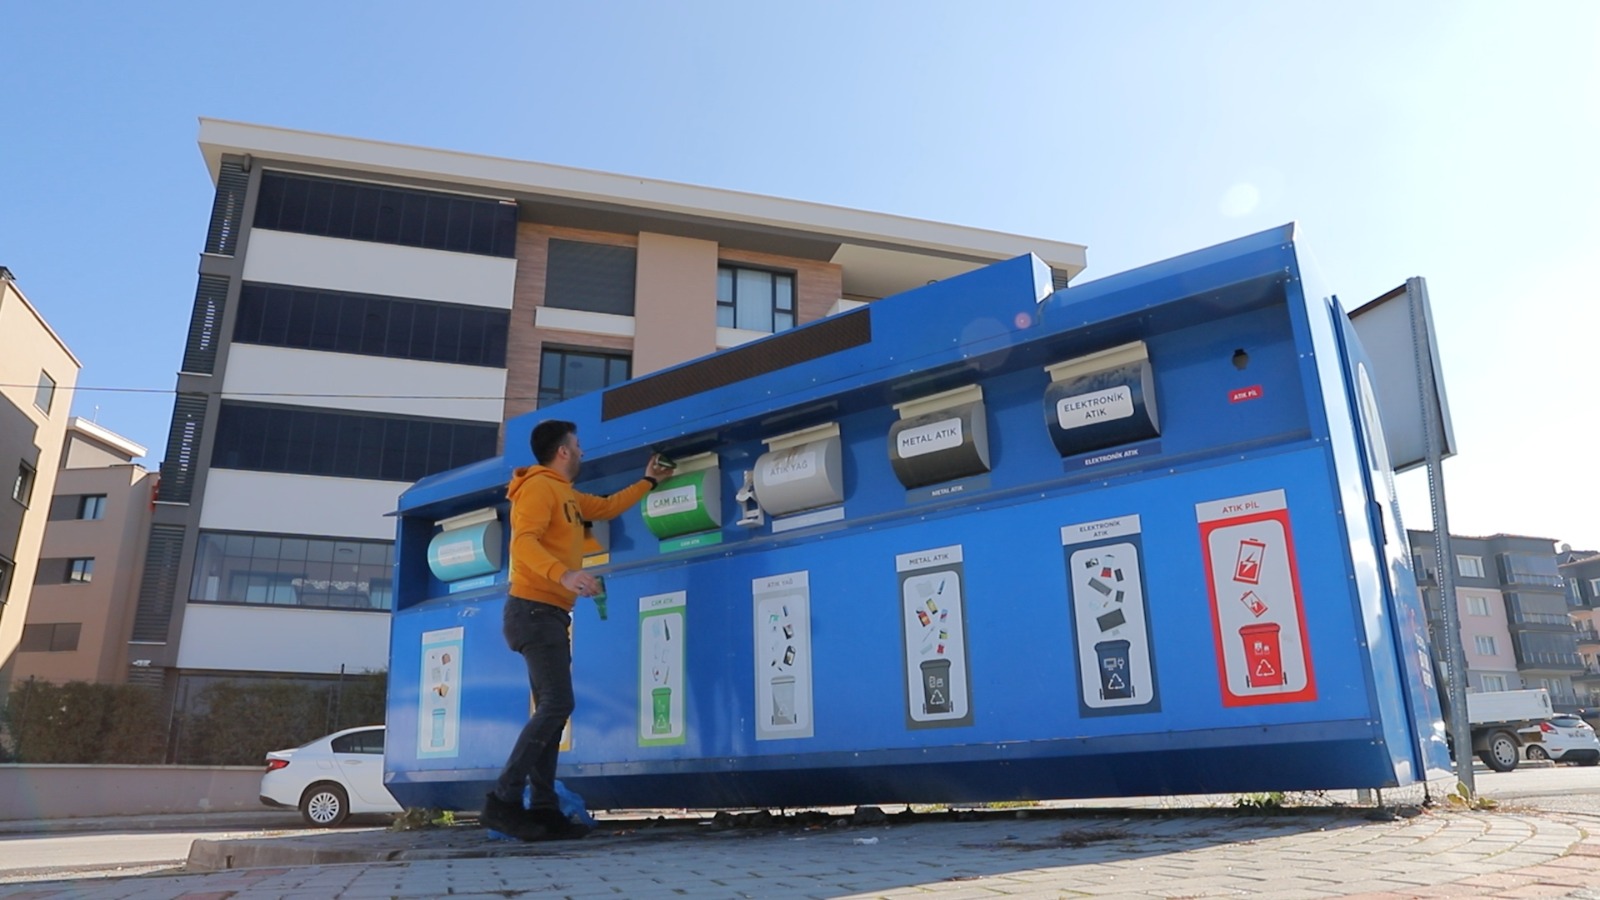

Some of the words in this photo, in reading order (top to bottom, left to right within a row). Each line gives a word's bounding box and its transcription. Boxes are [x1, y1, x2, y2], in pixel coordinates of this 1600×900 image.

[1064, 393, 1124, 412] ELEKTRONİK
[1085, 409, 1107, 419] ATIK
[902, 434, 932, 447] METAL
[935, 428, 957, 440] ATIK
[1084, 453, 1123, 466] ELEKTRONİK
[1124, 449, 1139, 458] ATIK
[770, 464, 789, 477] ATIK
[931, 488, 950, 496] METAL
[950, 485, 963, 493] ATIK
[653, 497, 670, 508] CAM
[672, 494, 689, 505] ATIK
[1222, 504, 1243, 514] ATIK
[1245, 501, 1259, 510] PİL
[1079, 520, 1120, 532] ELEKTRONİK
[909, 556, 931, 565] METAL
[933, 553, 949, 561] ATIK
